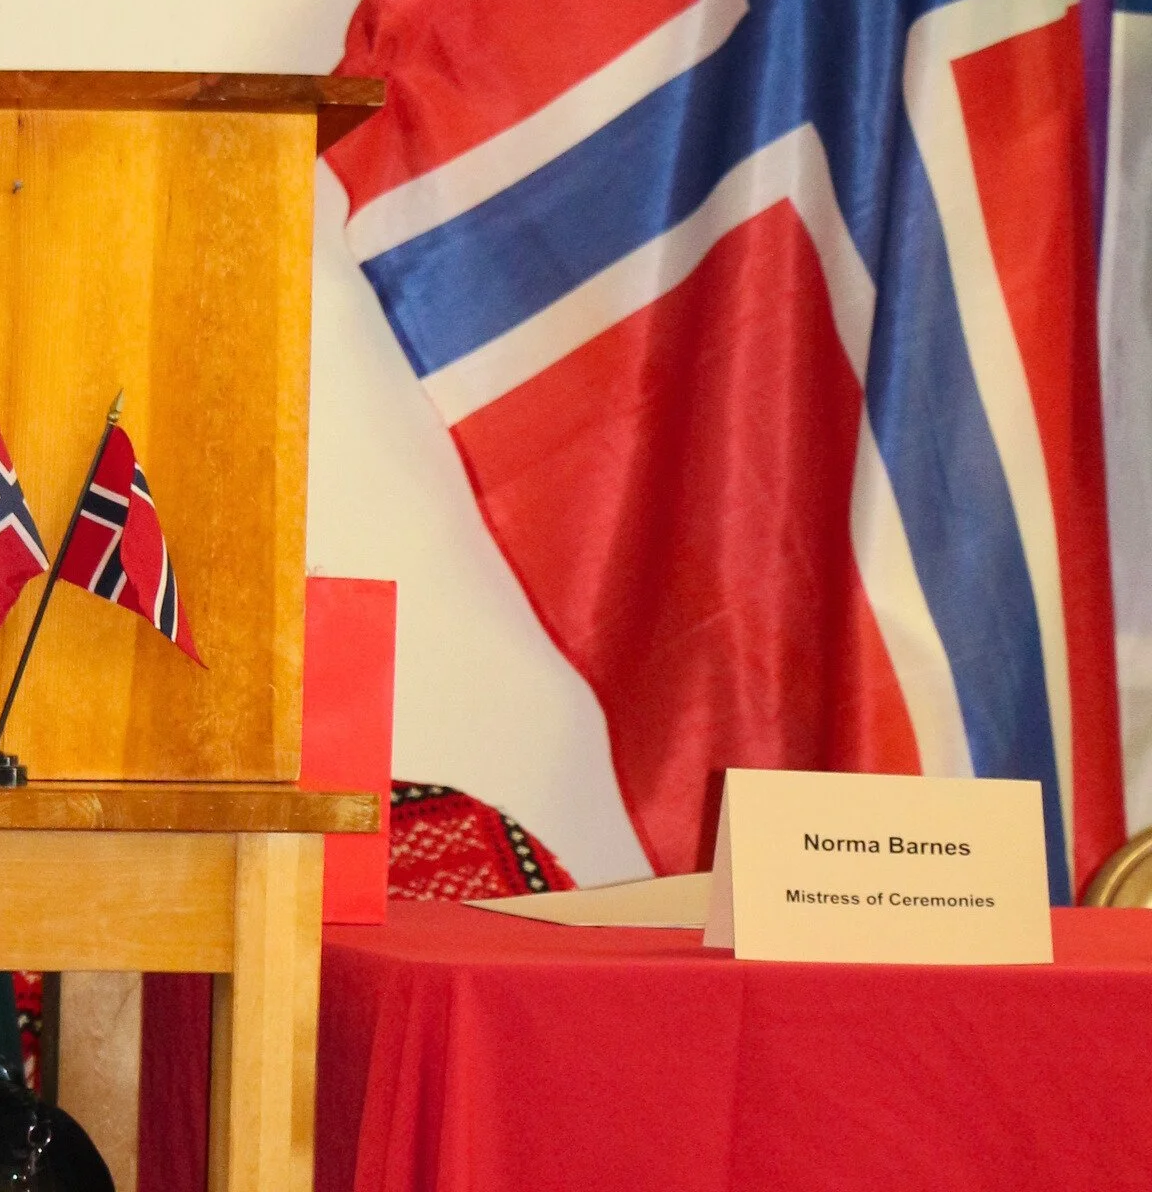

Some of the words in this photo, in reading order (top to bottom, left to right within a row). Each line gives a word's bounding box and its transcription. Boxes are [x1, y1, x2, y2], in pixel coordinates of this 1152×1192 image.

[804, 833, 880, 854] Norma
[888, 836, 971, 856] Barnes
[786, 889, 860, 906] Mistress
[866, 892, 884, 906] of
[889, 893, 995, 908] Ceremonies
